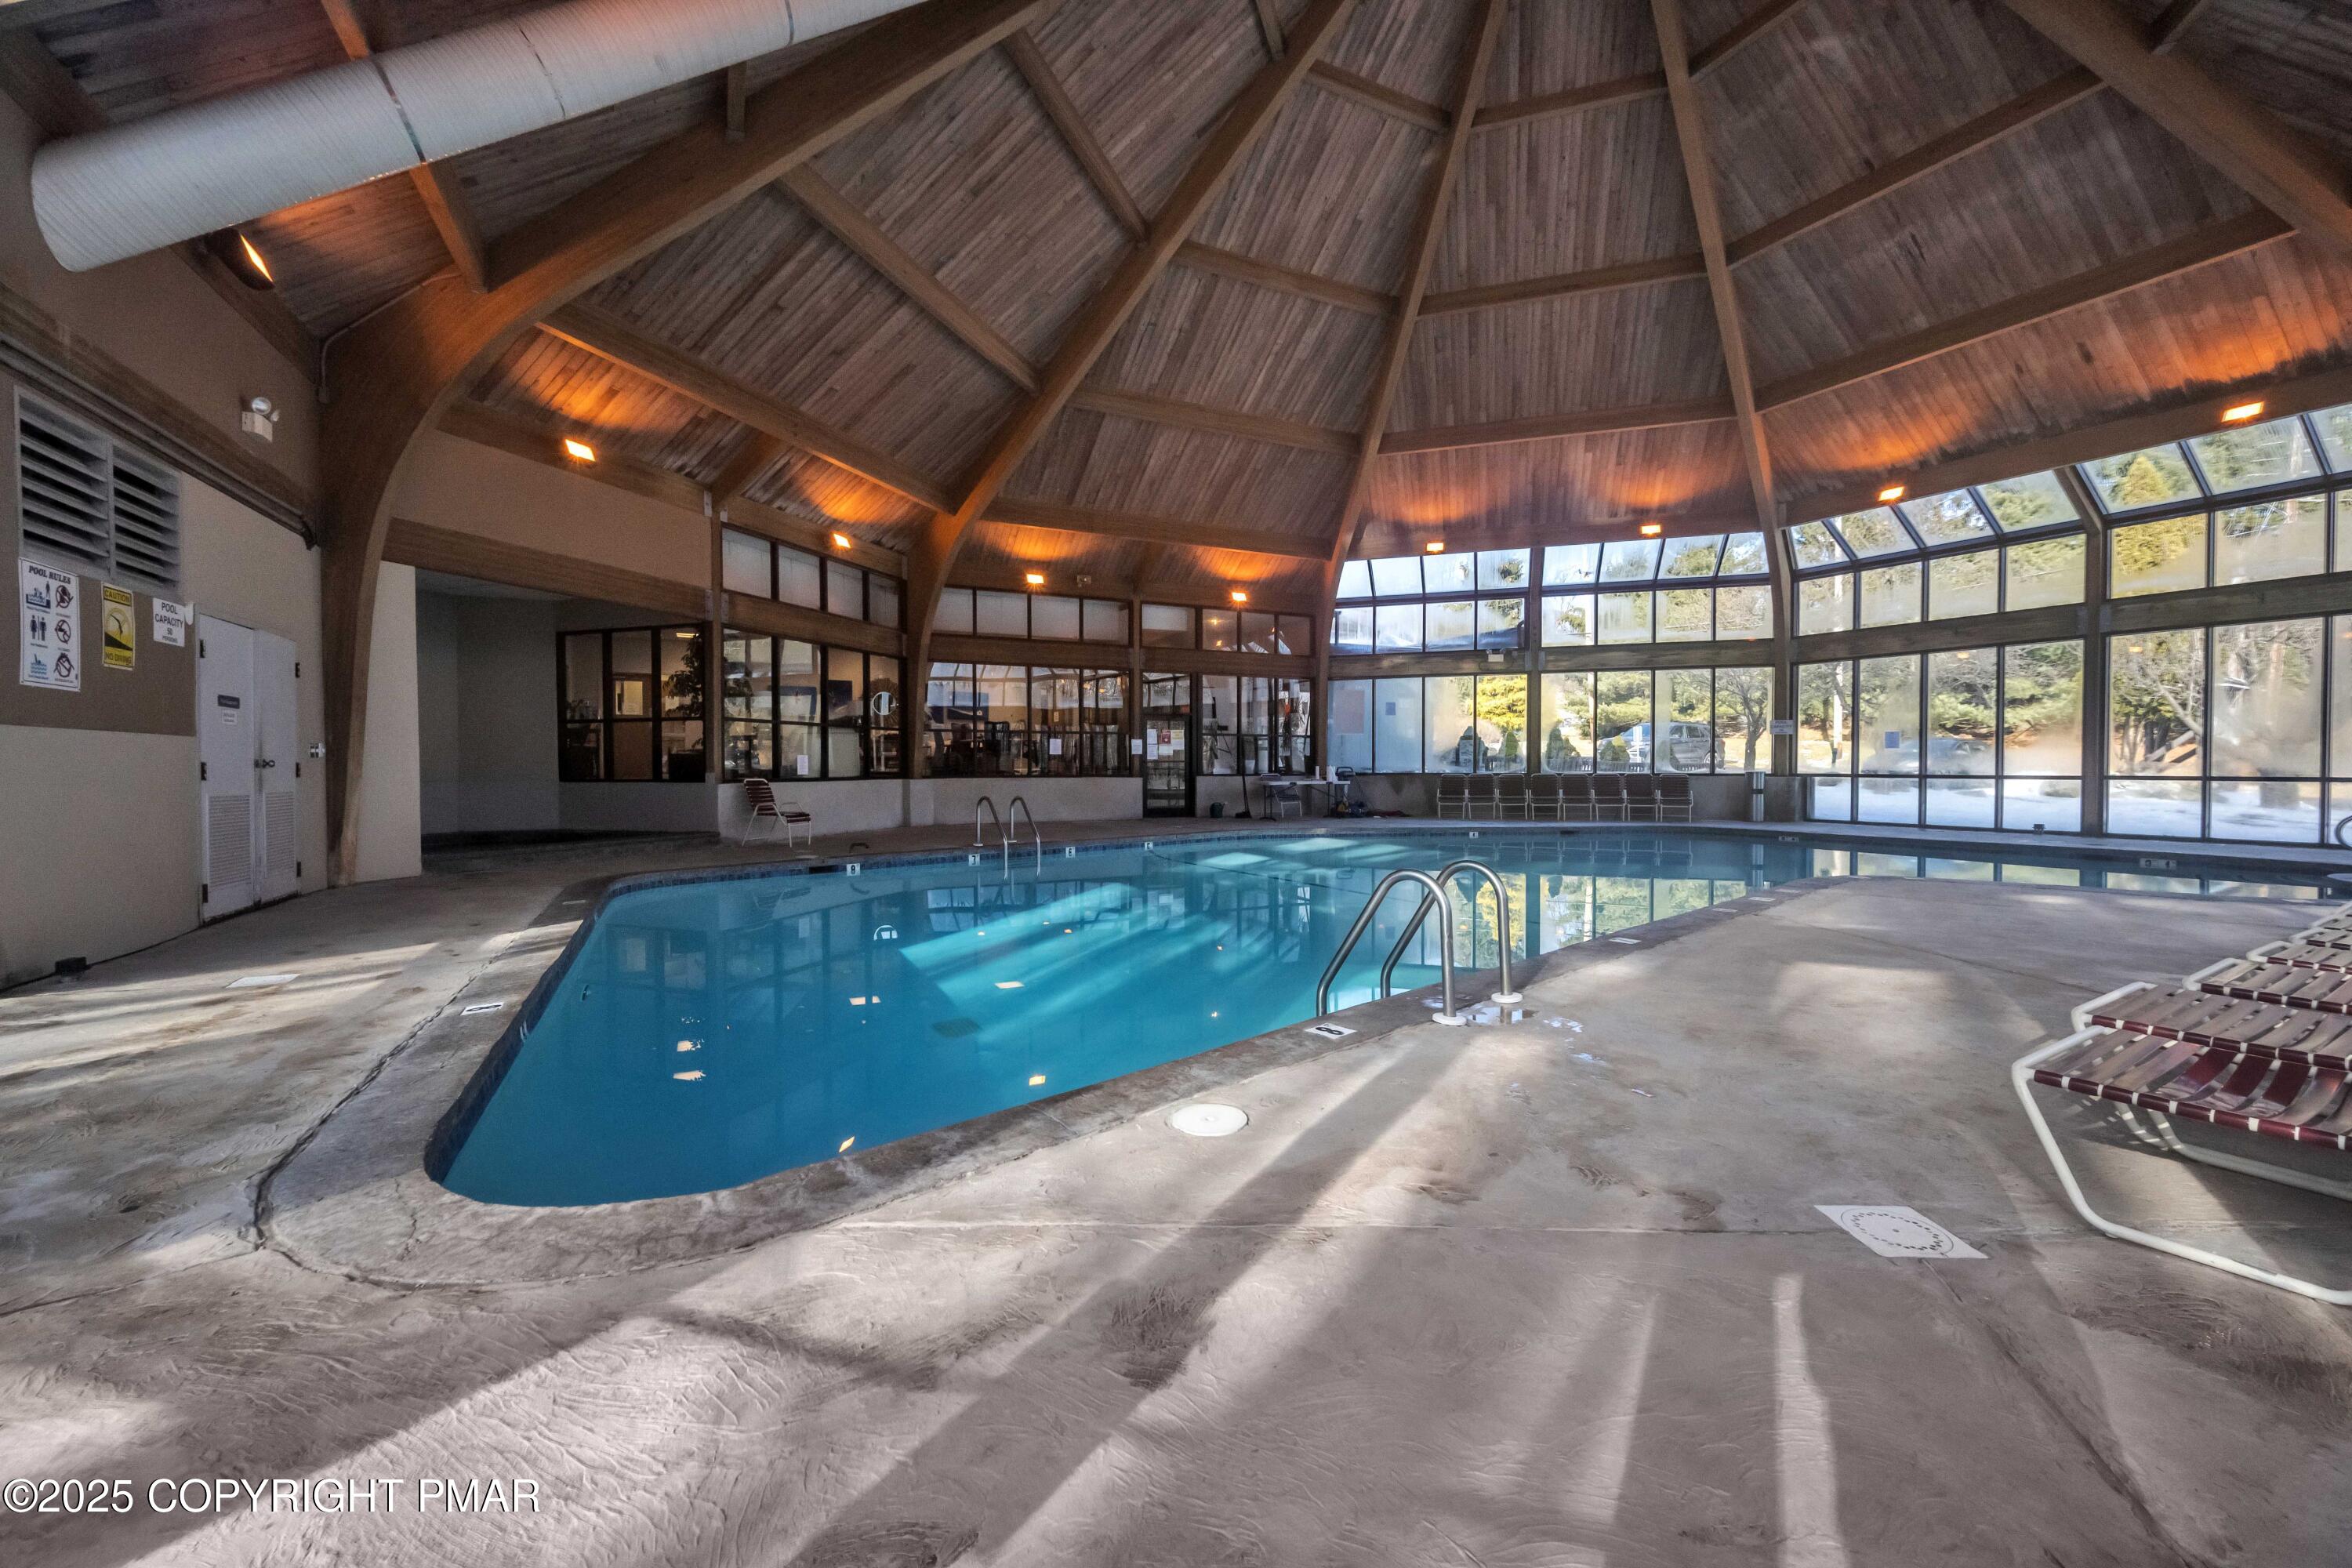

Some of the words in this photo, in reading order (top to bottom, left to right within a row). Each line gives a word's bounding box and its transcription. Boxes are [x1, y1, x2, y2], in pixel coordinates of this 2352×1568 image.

[28, 565, 47, 577] POOL
[49, 572, 71, 584] RULES
[104, 590, 130, 602] CAUTION
[162, 601, 178, 615] POOL
[154, 613, 183, 628] CAPACITY
[105, 652, 114, 661] NO
[114, 653, 132, 664] DIVING
